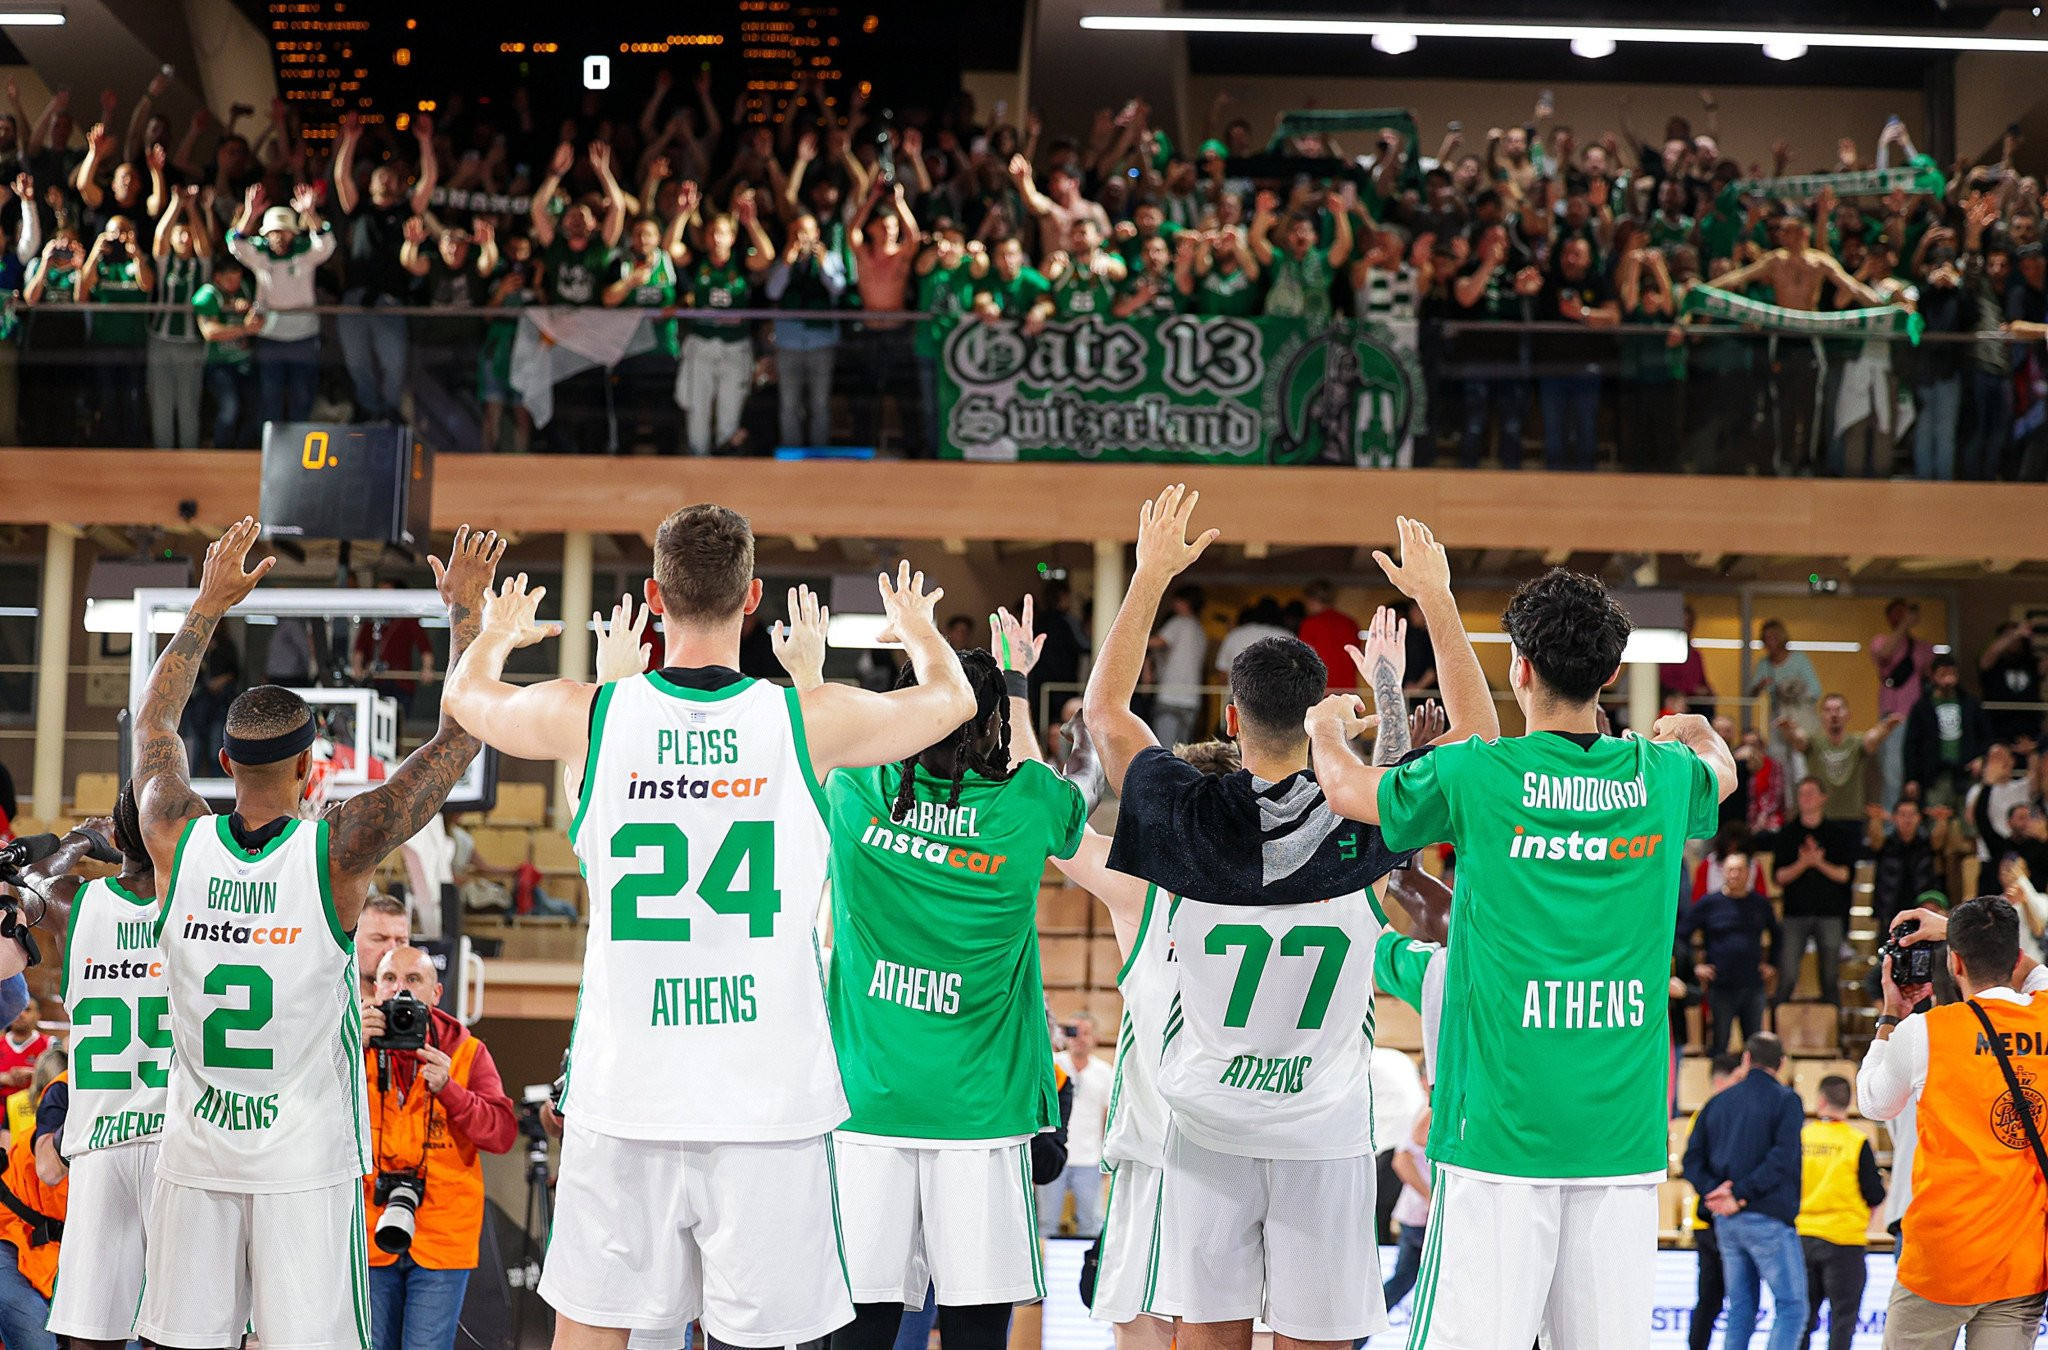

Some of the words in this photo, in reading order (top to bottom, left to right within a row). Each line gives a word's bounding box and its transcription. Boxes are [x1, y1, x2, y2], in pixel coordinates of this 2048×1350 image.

[946, 316, 1147, 391] Gate
[1157, 317, 1263, 395] 13
[948, 391, 1260, 456] Switzerland
[658, 728, 739, 766] PLEISS
[628, 772, 768, 800] instacar
[1522, 772, 1648, 812] SAMODUROV
[861, 816, 1007, 875] instacar
[1509, 826, 1663, 862] instacar
[207, 876, 277, 914] BROWN
[610, 820, 781, 942] 24
[183, 914, 302, 945] instacar
[651, 974, 758, 1027] ATHENS
[867, 959, 963, 1015] ATHENS
[1204, 923, 1352, 1030] 77
[202, 963, 274, 1070] 2
[1522, 979, 1645, 1029] ATHENS
[72, 996, 174, 1090] 25
[1975, 1031, 2048, 1057] MEDI
[1219, 1055, 1313, 1094] ATHENS
[194, 1084, 279, 1131] ATHENS
